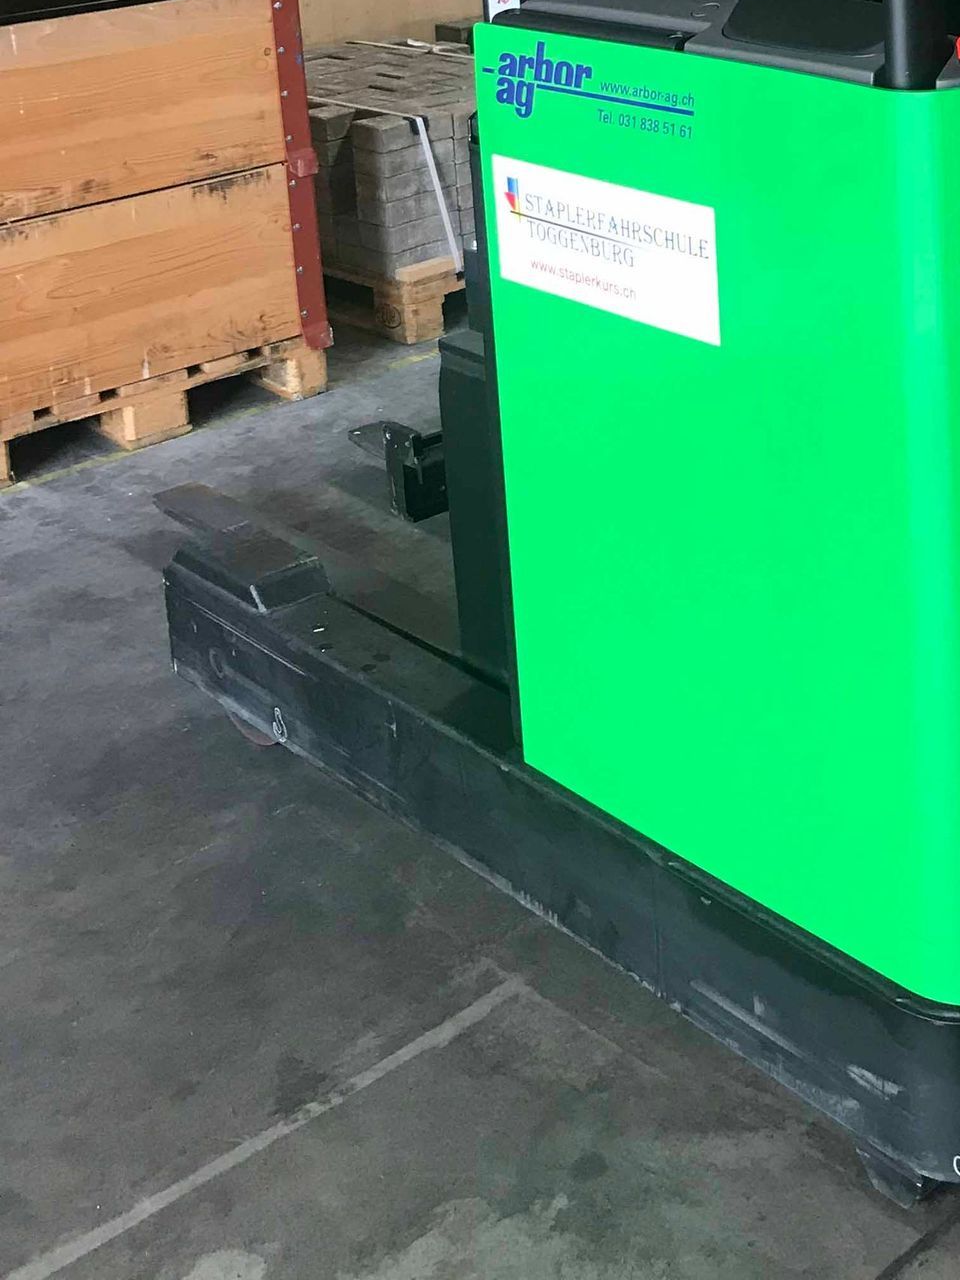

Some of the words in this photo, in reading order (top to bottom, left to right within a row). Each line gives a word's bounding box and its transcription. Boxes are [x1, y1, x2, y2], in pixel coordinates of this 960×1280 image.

[498, 41, 593, 89] arbor
[496, 76, 535, 119] ag
[600, 81, 695, 107] www.arbor-ag.ch
[618, 113, 637, 129] 031
[640, 117, 660, 133] 838
[662, 121, 675, 136] 51
[679, 124, 692, 139] 61
[524, 192, 710, 260] STAPLERFAHRSCHULE
[526, 219, 635, 268] TOGGENBURG
[530, 258, 637, 300] www.staplerkurs.ch
